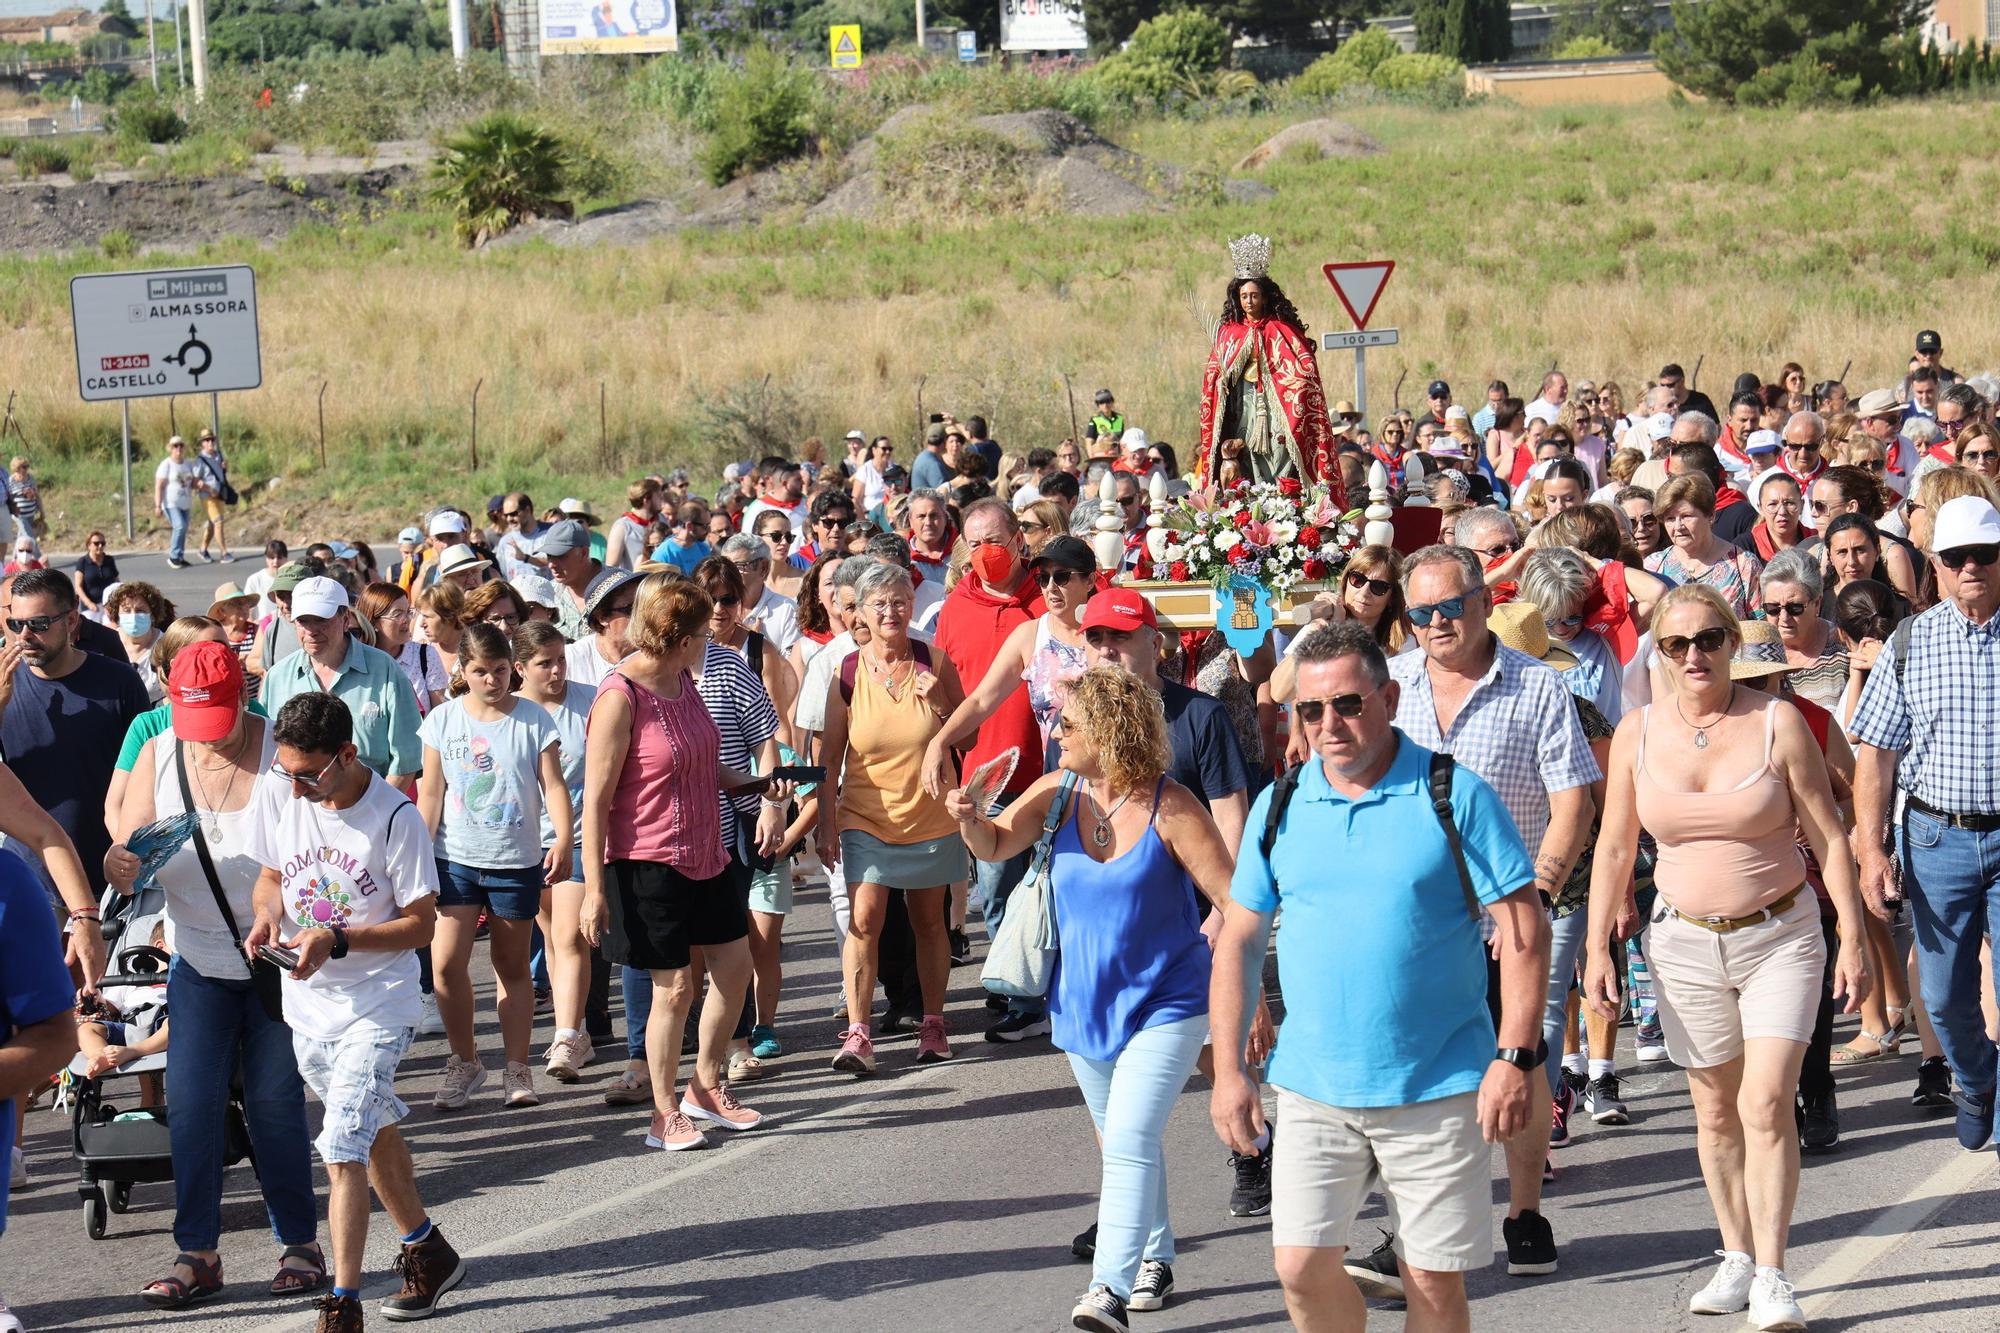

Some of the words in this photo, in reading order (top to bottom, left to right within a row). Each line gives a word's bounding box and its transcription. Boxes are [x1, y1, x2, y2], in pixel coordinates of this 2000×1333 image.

[170, 279, 225, 296] Mijares
[149, 300, 248, 318] ALMASSORA
[1342, 335, 1365, 345] 100
[1371, 335, 1380, 343] m
[102, 356, 149, 370] N-340a
[86, 370, 167, 390] CASTELLÓ
[446, 733, 468, 751] just
[282, 848, 314, 889] SOM
[317, 846, 359, 876] COM
[354, 868, 378, 897] TU
